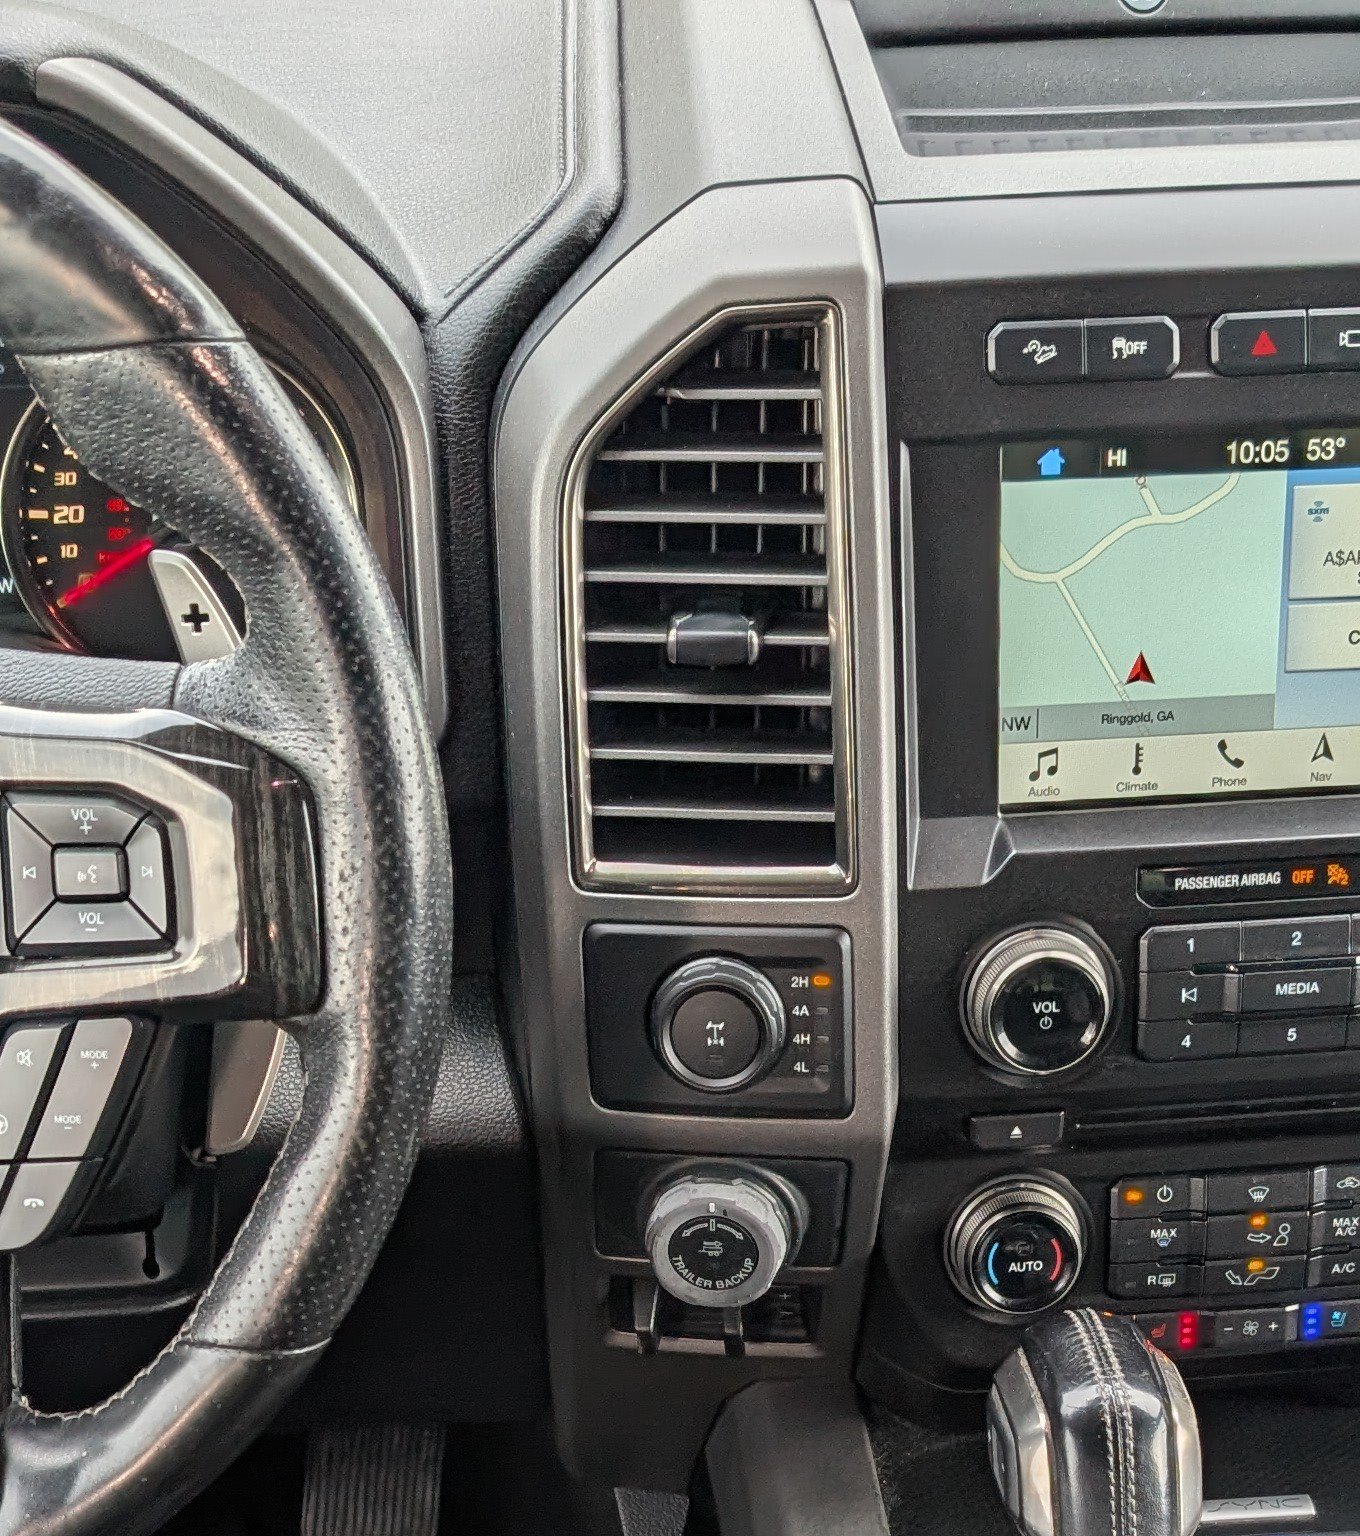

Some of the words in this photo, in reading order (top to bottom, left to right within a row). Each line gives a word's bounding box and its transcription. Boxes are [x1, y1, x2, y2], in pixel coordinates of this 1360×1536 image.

[1126, 340, 1148, 355] OFF
[1107, 448, 1128, 467] HI
[1227, 440, 1290, 464] 10:05
[54, 472, 77, 486] 30
[53, 505, 85, 525] 20
[60, 544, 79, 559] 10
[1001, 716, 1031, 732] NW
[1101, 712, 1153, 726] Ringgold,
[1156, 710, 1175, 722] GA
[1211, 776, 1247, 788] Phone
[1310, 772, 1332, 782] Nav
[1027, 785, 1061, 798] Audio
[1116, 780, 1159, 793] Climate
[70, 808, 99, 822] VOL
[1174, 874, 1239, 890] PASSENGER
[1241, 870, 1281, 886] AIRBAG
[1292, 869, 1315, 884] OFF
[78, 912, 105, 925] VOL
[1186, 938, 1195, 952] 1
[1292, 931, 1302, 946] 2
[790, 976, 809, 988] 2H
[1275, 981, 1320, 996] MEDIA
[792, 1004, 810, 1016] 4A
[1033, 1001, 1061, 1014] VOL
[792, 1034, 811, 1045] 4H
[1180, 1034, 1192, 1048] 4
[1286, 1028, 1297, 1042] 5
[80, 1050, 109, 1060] MODE
[793, 1061, 809, 1073] 4L
[54, 1115, 83, 1125] MODE
[1332, 1216, 1360, 1228] MAX
[1150, 1228, 1178, 1239] MAX
[1334, 1226, 1358, 1237] A/C
[671, 1254, 713, 1289] TRAILER
[715, 1257, 755, 1289] BACKUP
[1008, 1261, 1044, 1273] AUTO
[1331, 1262, 1356, 1274] A/C
[1147, 1275, 1157, 1285] R
[1207, 1497, 1303, 1513] SYNC
